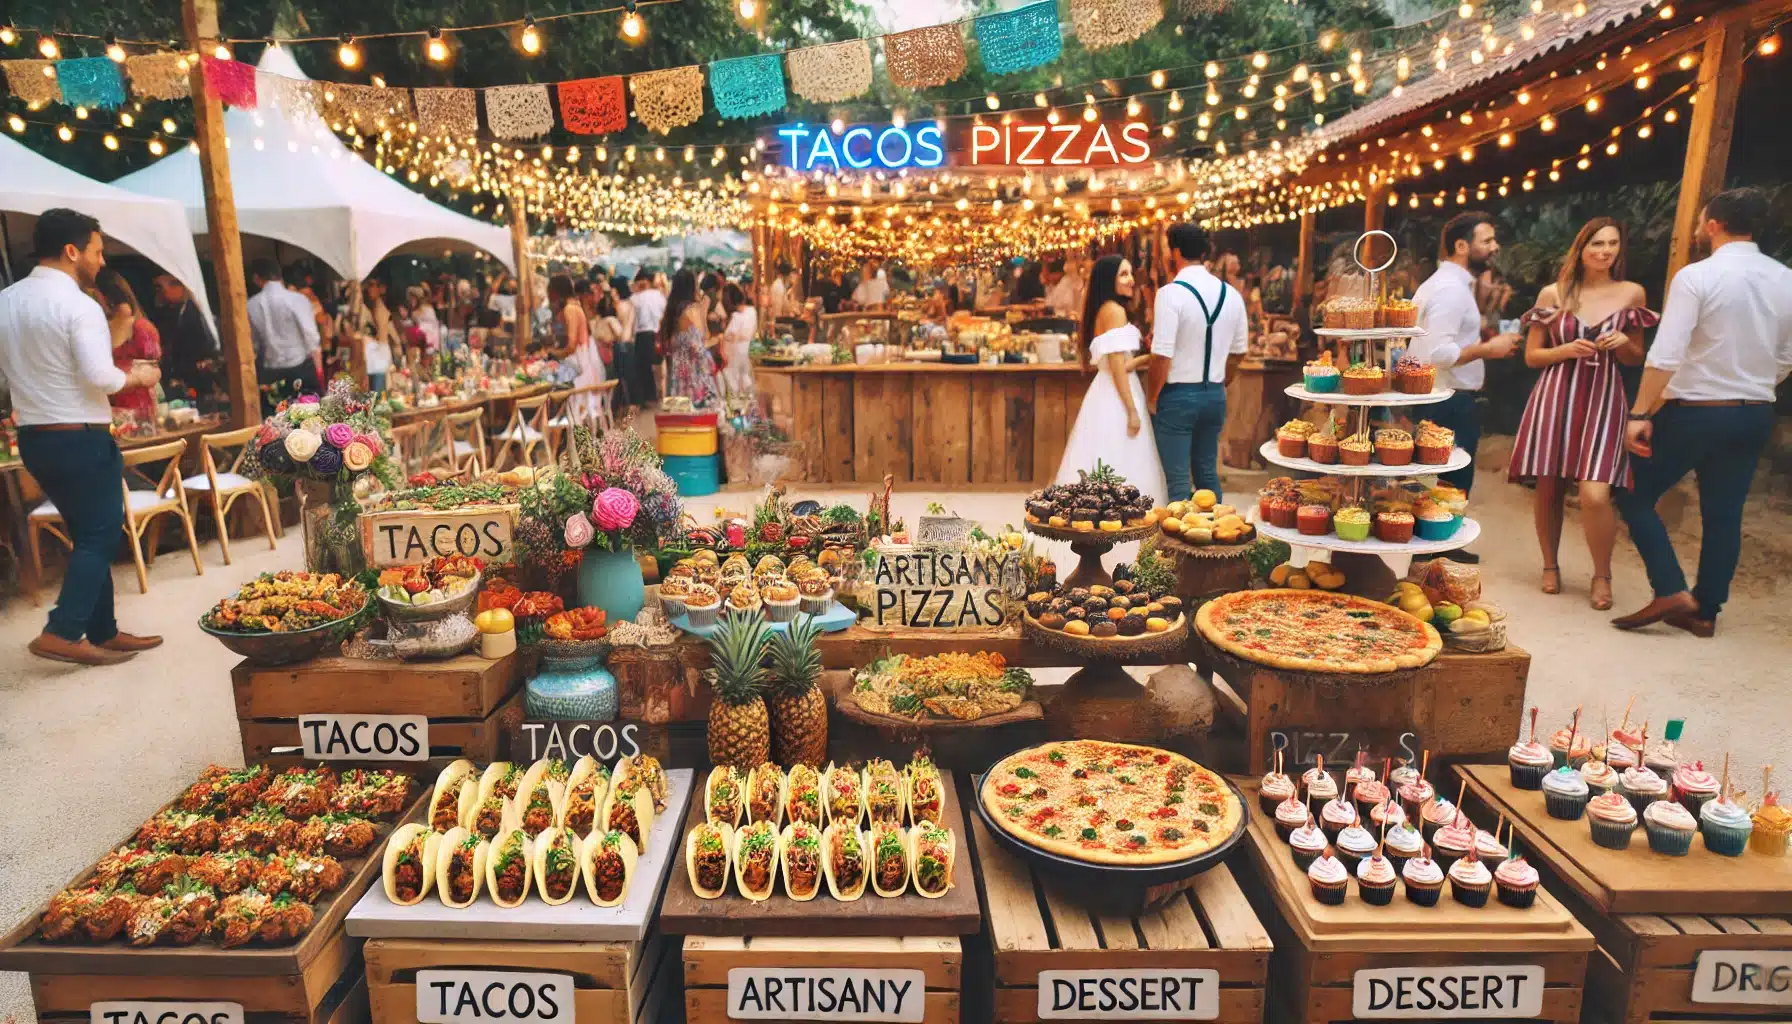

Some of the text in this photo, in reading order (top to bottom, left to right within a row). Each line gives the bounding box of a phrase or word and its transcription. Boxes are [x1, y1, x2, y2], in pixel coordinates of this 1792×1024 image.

[778, 123, 1151, 169] TACOS PIZZAS
[379, 521, 503, 558] TACOS
[875, 552, 1008, 586] ARTISANY
[877, 588, 1004, 627] PIZZAS
[304, 720, 420, 755] TACOS
[521, 724, 640, 760] TACOS
[1270, 731, 1416, 765] PIZZS
[430, 981, 558, 1018] TACOS
[738, 977, 911, 1014] ARTISANY
[1052, 977, 1203, 1011] DESSERT
[1368, 974, 1527, 1010] DESSERT
